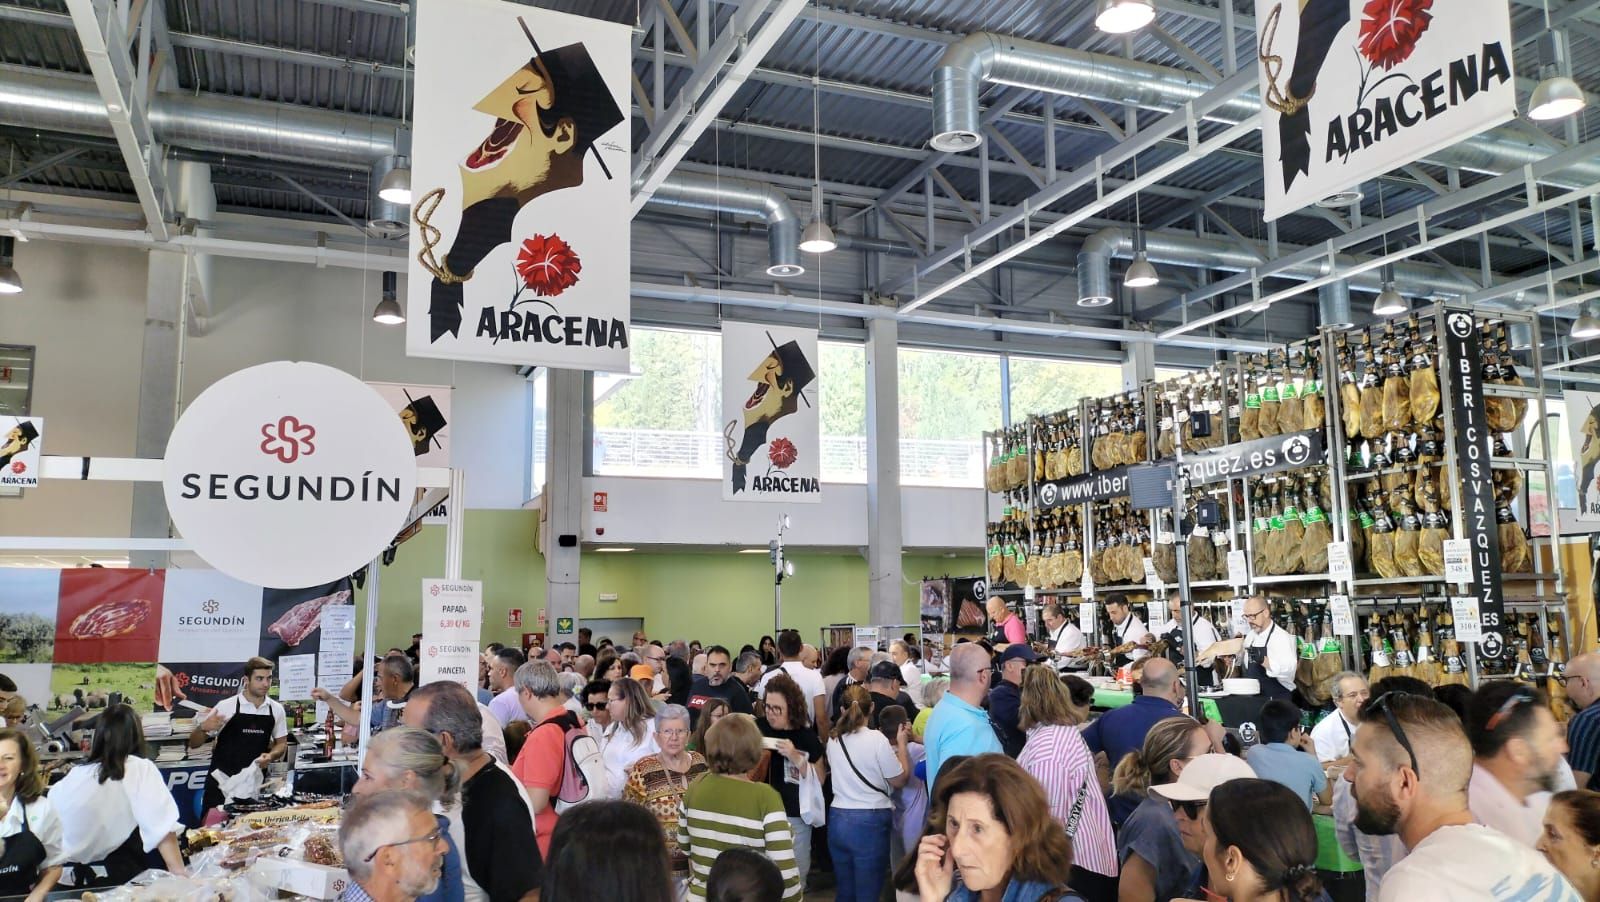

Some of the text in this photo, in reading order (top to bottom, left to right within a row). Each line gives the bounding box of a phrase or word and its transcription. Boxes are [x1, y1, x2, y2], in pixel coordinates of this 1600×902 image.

[1325, 40, 1511, 164] ARACENA
[476, 306, 629, 349] ARACENA
[1, 476, 37, 485] ARACENA
[752, 475, 820, 493] ARACENA
[181, 470, 400, 502] SEGUNDÍN
[441, 584, 473, 592] SEGUNDÍN
[442, 605, 467, 613] PAPADA
[179, 615, 245, 626] SEGUNDÍN
[439, 645, 471, 653] SEGUNDÍN
[438, 666, 466, 675] PANCETA
